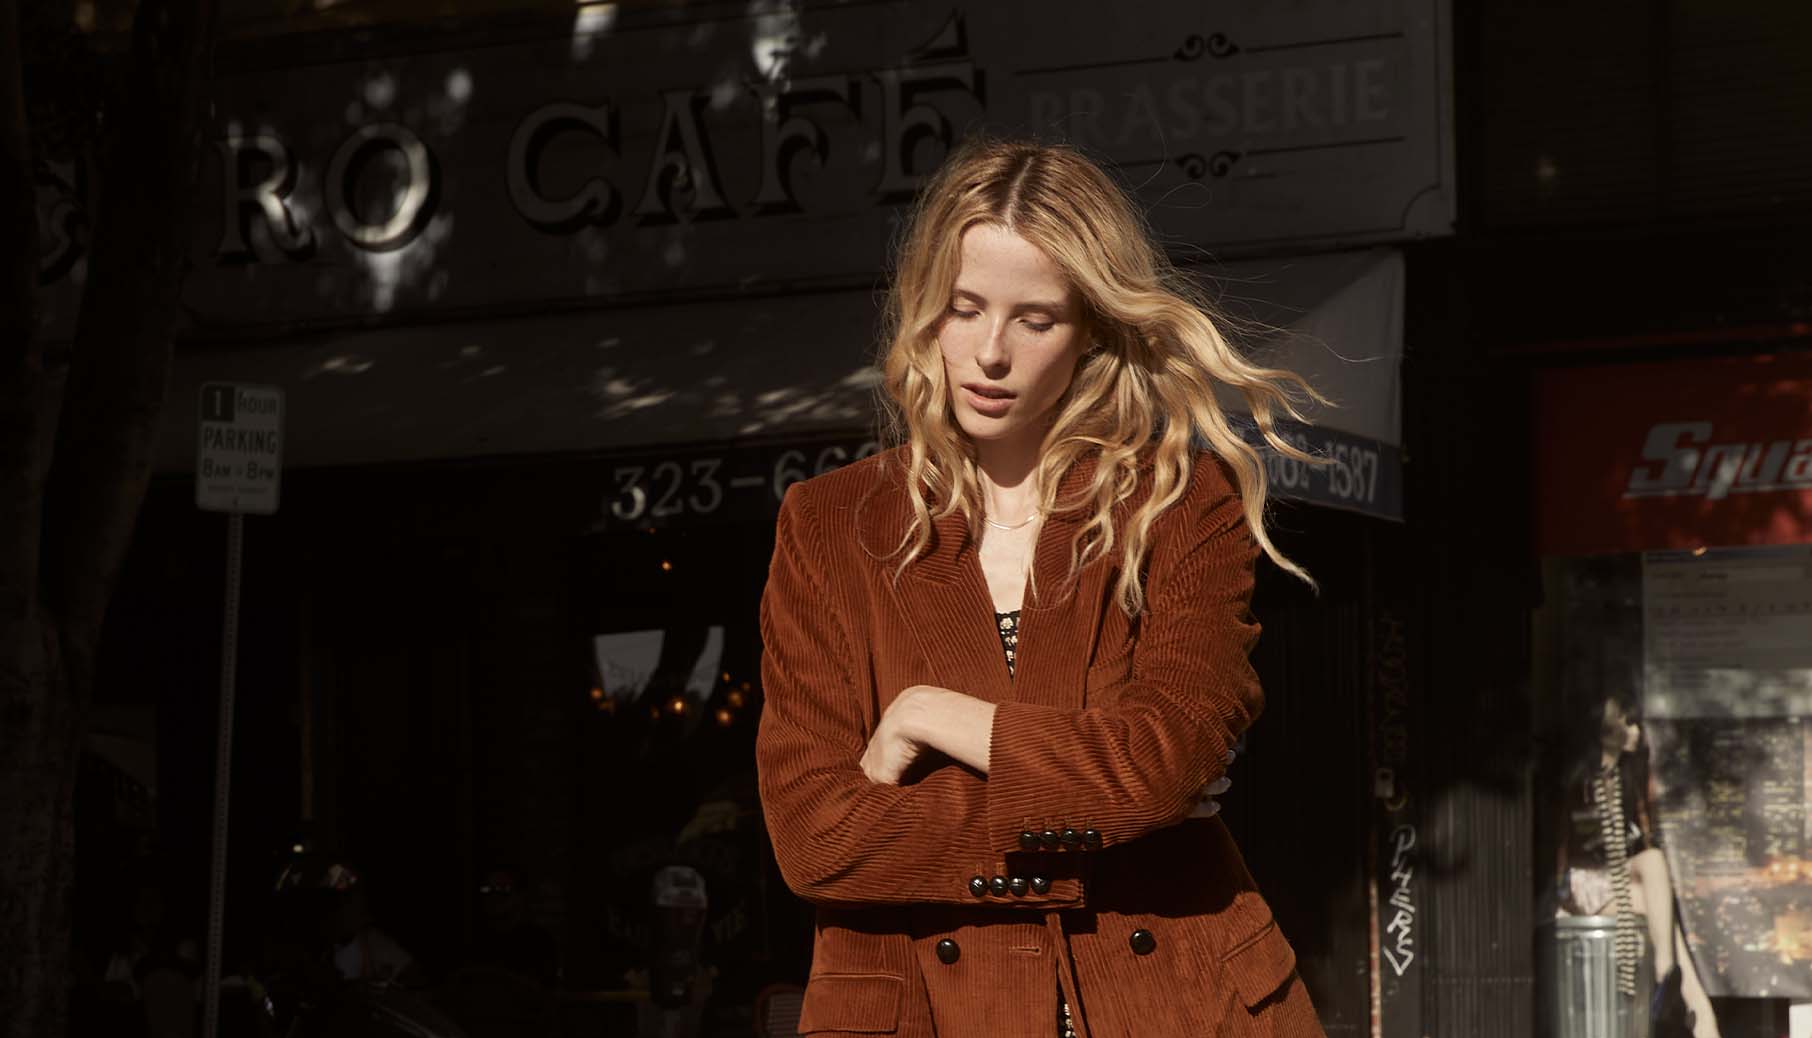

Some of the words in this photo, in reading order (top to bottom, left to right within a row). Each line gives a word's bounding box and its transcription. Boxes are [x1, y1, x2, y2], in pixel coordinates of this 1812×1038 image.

[505, 8, 987, 235] CAFÉ
[1027, 57, 1390, 147] BRASSERIE
[214, 389, 222, 416] 1
[203, 426, 279, 454] PARKING
